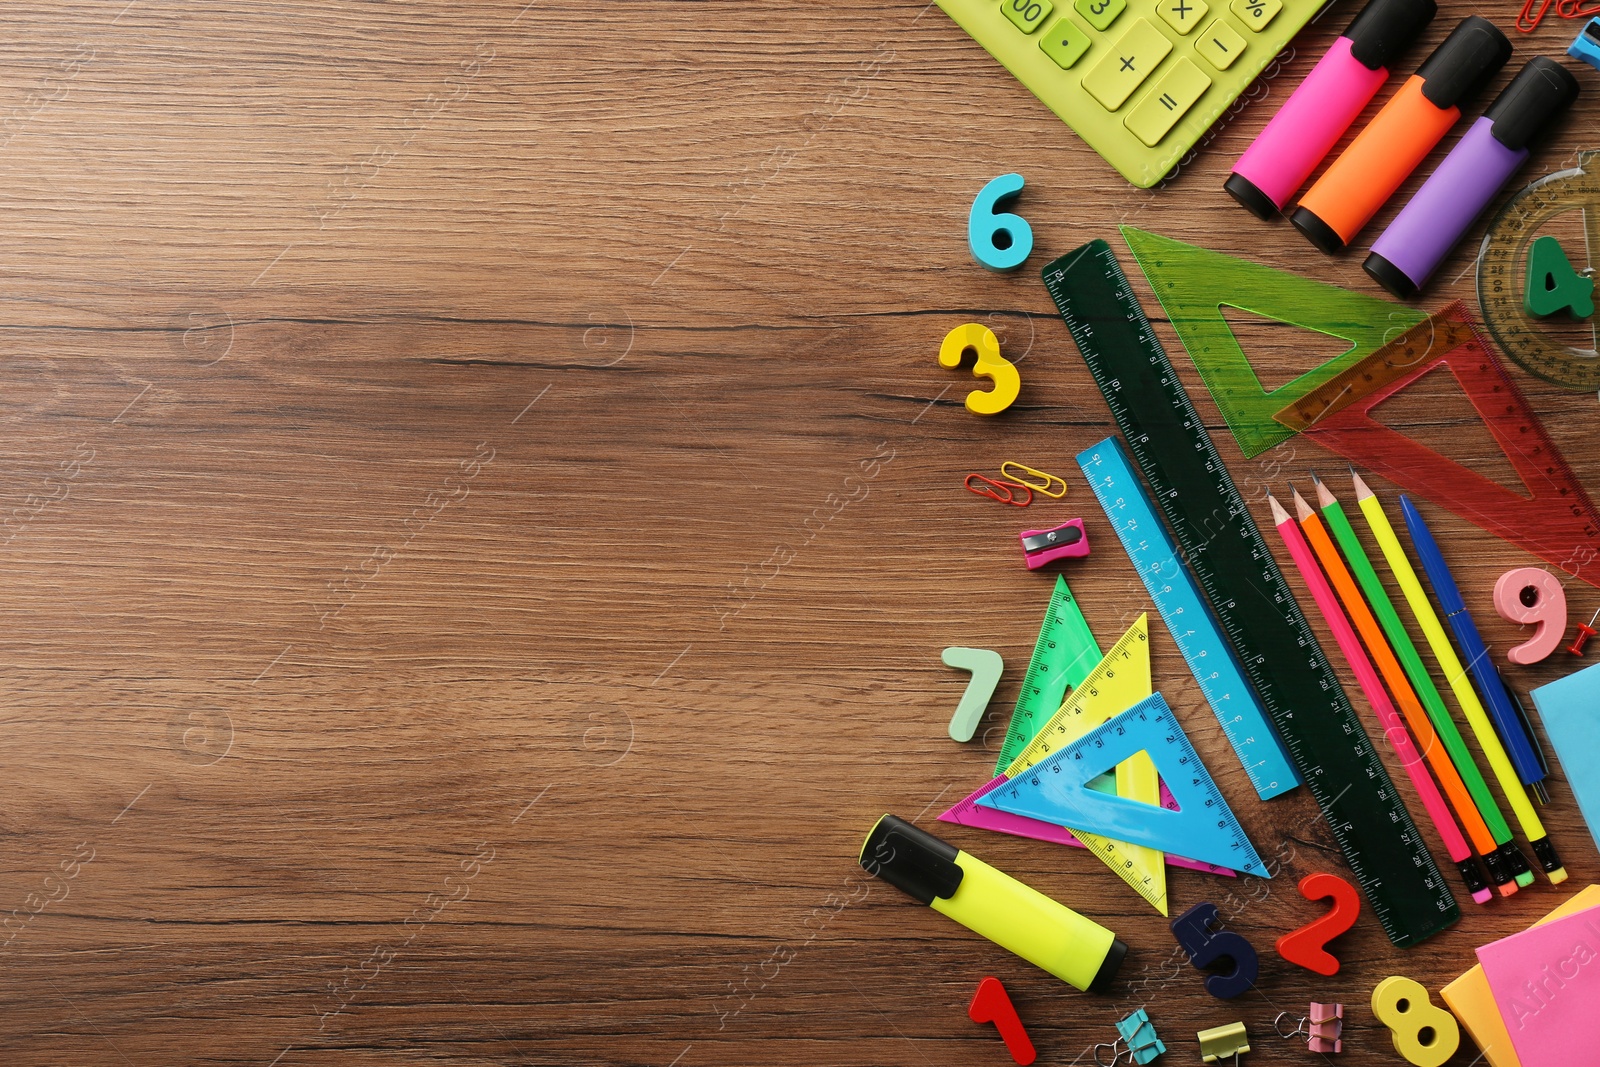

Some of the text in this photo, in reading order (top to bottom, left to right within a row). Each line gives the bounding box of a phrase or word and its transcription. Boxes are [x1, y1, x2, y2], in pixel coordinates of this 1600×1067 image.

[967, 172, 1034, 273] 6
[1493, 279, 1504, 293] 90
[1522, 235, 1596, 320] 4
[938, 322, 1021, 417] 3
[1055, 271, 1065, 283] 12
[1083, 324, 1094, 337] 11
[1112, 380, 1122, 392] 10
[1140, 434, 1149, 444] 9
[1170, 490, 1178, 498] 8
[1228, 601, 1236, 609] 6
[1257, 656, 1265, 664] 5
[1285, 712, 1294, 720] 4
[1314, 767, 1324, 776] 3
[1344, 823, 1353, 833] 2
[1374, 880, 1382, 888] 1
[1090, 452, 1279, 790] 15 14 13 12 11 10 9 8 7 6 5 4 3 2 1 0
[1104, 269, 1112, 277] 1
[1114, 290, 1123, 299] 2
[1138, 334, 1146, 342] 4
[1160, 377, 1168, 385] 6
[1172, 399, 1180, 407] 7
[1183, 421, 1191, 429] 8
[1194, 442, 1202, 450] 9
[1204, 461, 1214, 472] 10
[1216, 483, 1225, 494] 11
[1239, 527, 1249, 539] 13
[1250, 549, 1260, 561] 14
[1262, 570, 1272, 583] 15
[1273, 592, 1283, 604] 16
[1285, 614, 1295, 626] 17
[1296, 635, 1306, 648] 18
[1308, 657, 1318, 669] 19
[1318, 678, 1329, 691] 20
[1330, 701, 1340, 713] 21
[1341, 723, 1352, 736] 22
[1353, 745, 1364, 758] 23
[1365, 767, 1375, 779] 24
[1377, 789, 1387, 801] 25
[1388, 810, 1399, 823] 26
[1400, 833, 1410, 845] 27
[1412, 855, 1422, 867] 28
[1424, 877, 1434, 890] 29
[1436, 899, 1447, 911] 30
[1492, 567, 1568, 665] 9
[940, 646, 1004, 743] 7
[1017, 595, 1071, 742] 2 3 4 5 6 7 8
[1041, 744, 1051, 753] 2
[1057, 725, 1067, 734] 3
[1074, 707, 1082, 716] 4
[1090, 689, 1099, 697] 5
[1105, 670, 1114, 679] 6
[1122, 652, 1130, 660] 7
[1138, 633, 1147, 642] 8
[1010, 714, 1146, 799] 1 2 3 4 5 6 7
[1155, 715, 1162, 723] 1
[1166, 735, 1175, 743] 2
[1179, 756, 1188, 764] 3
[1204, 799, 1213, 807] 5
[1217, 820, 1226, 828] 6
[1230, 841, 1239, 849] 7
[1243, 863, 1252, 871] 8
[1106, 844, 1152, 885] 5 6 7
[1169, 901, 1259, 1000] 5
[1274, 871, 1361, 977] 2
[967, 975, 1037, 1067] 1
[1370, 975, 1461, 1067] 8
